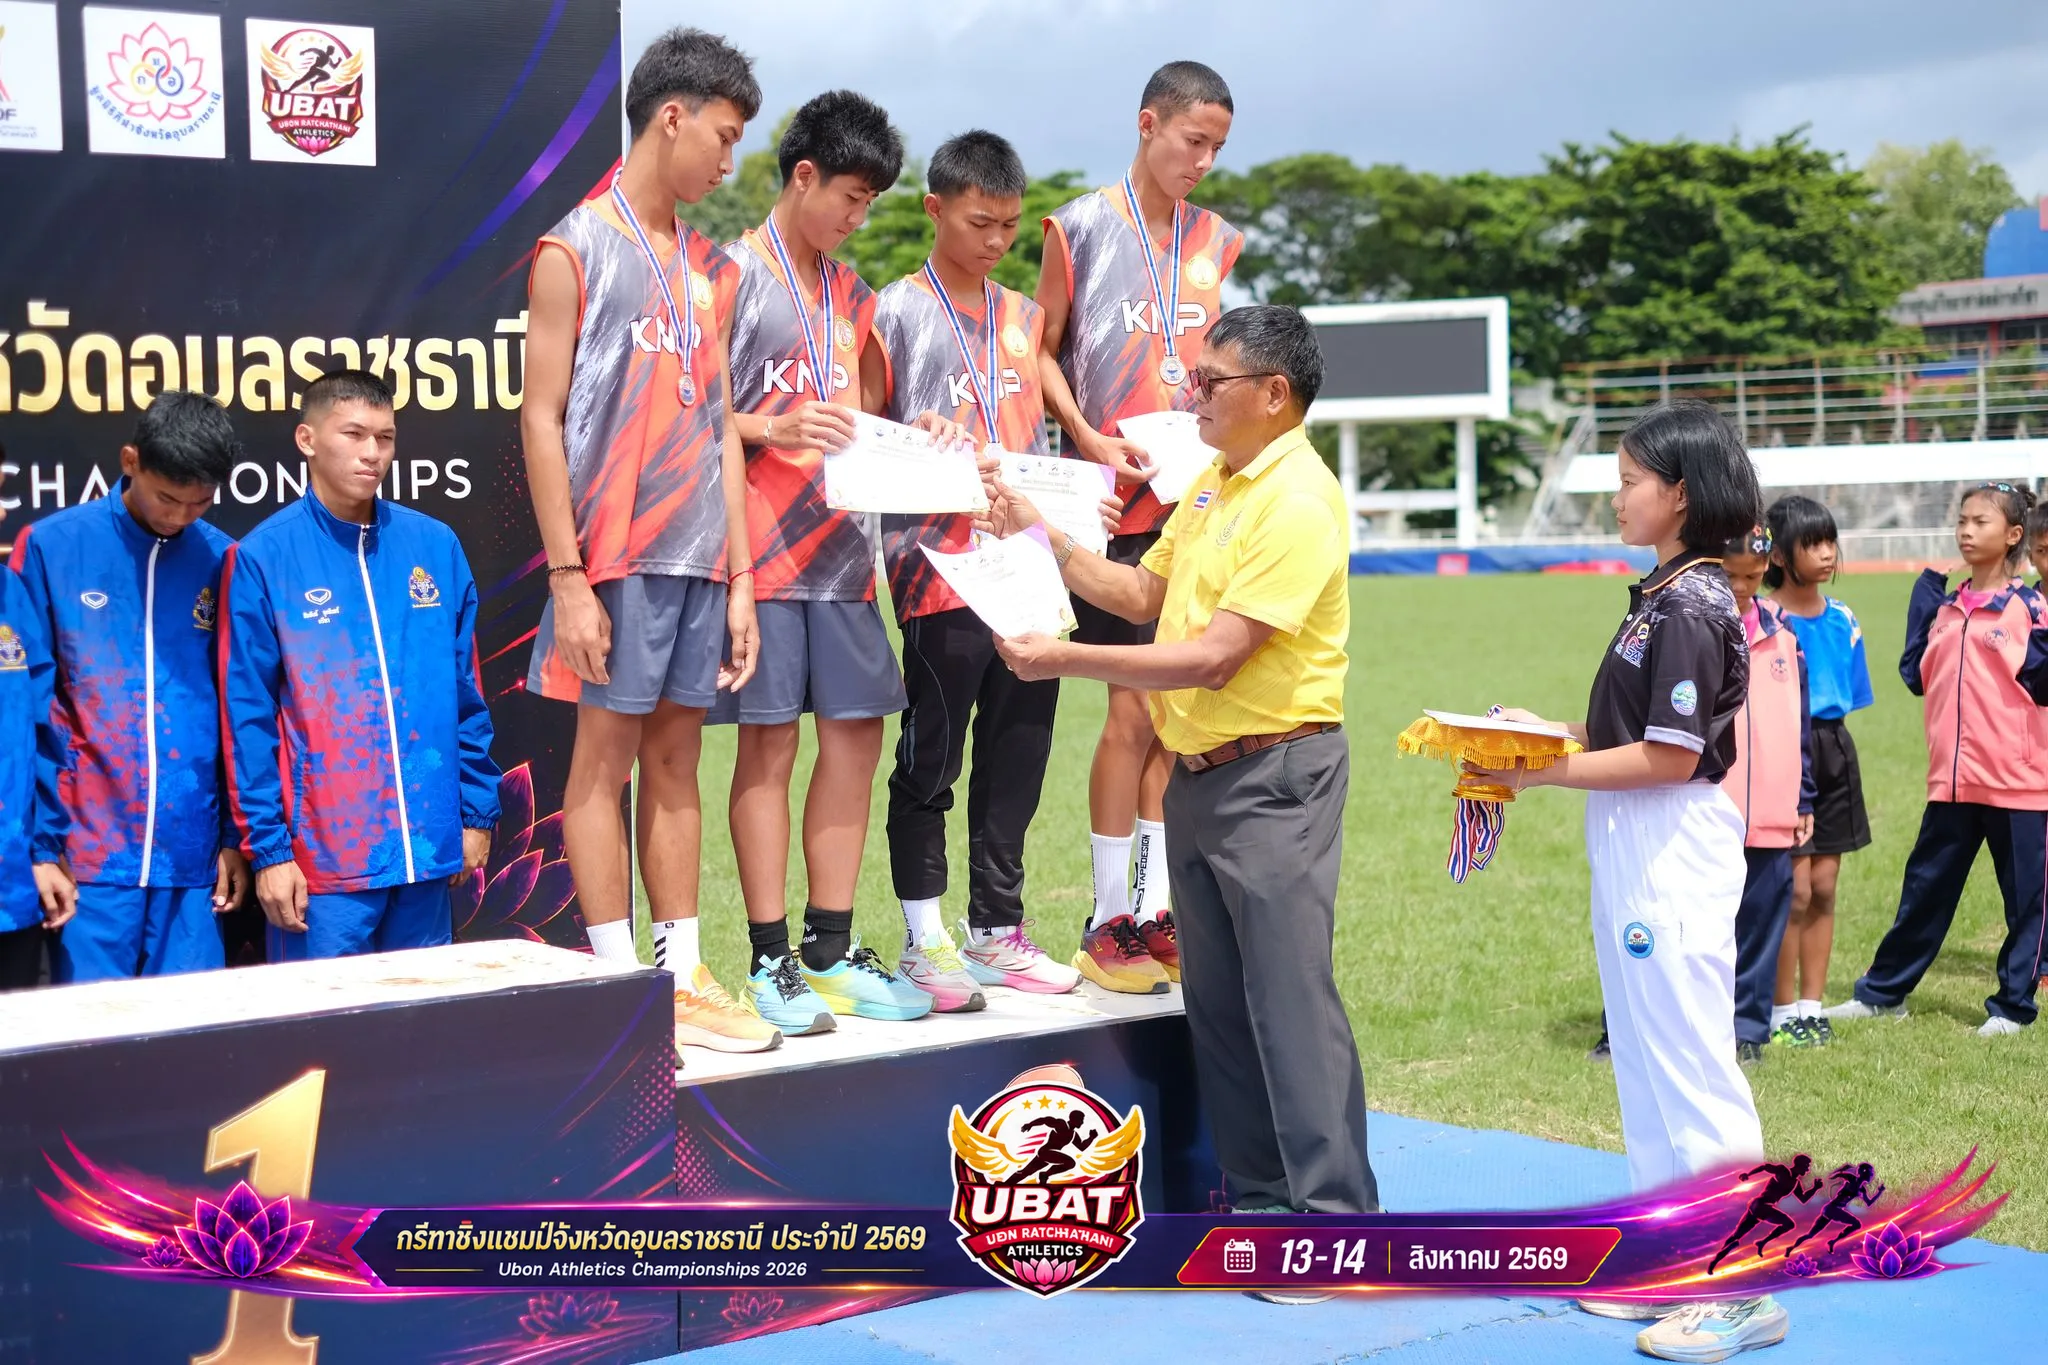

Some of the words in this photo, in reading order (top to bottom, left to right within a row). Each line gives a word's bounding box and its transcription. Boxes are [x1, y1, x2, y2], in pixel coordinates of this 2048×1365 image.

[269, 92, 357, 121] UBAT
[278, 119, 300, 129] UBON
[292, 127, 336, 138] ATHLETICS
[1139, 834, 1151, 886] TAPEDESIGN
[190, 1069, 327, 1365] 1
